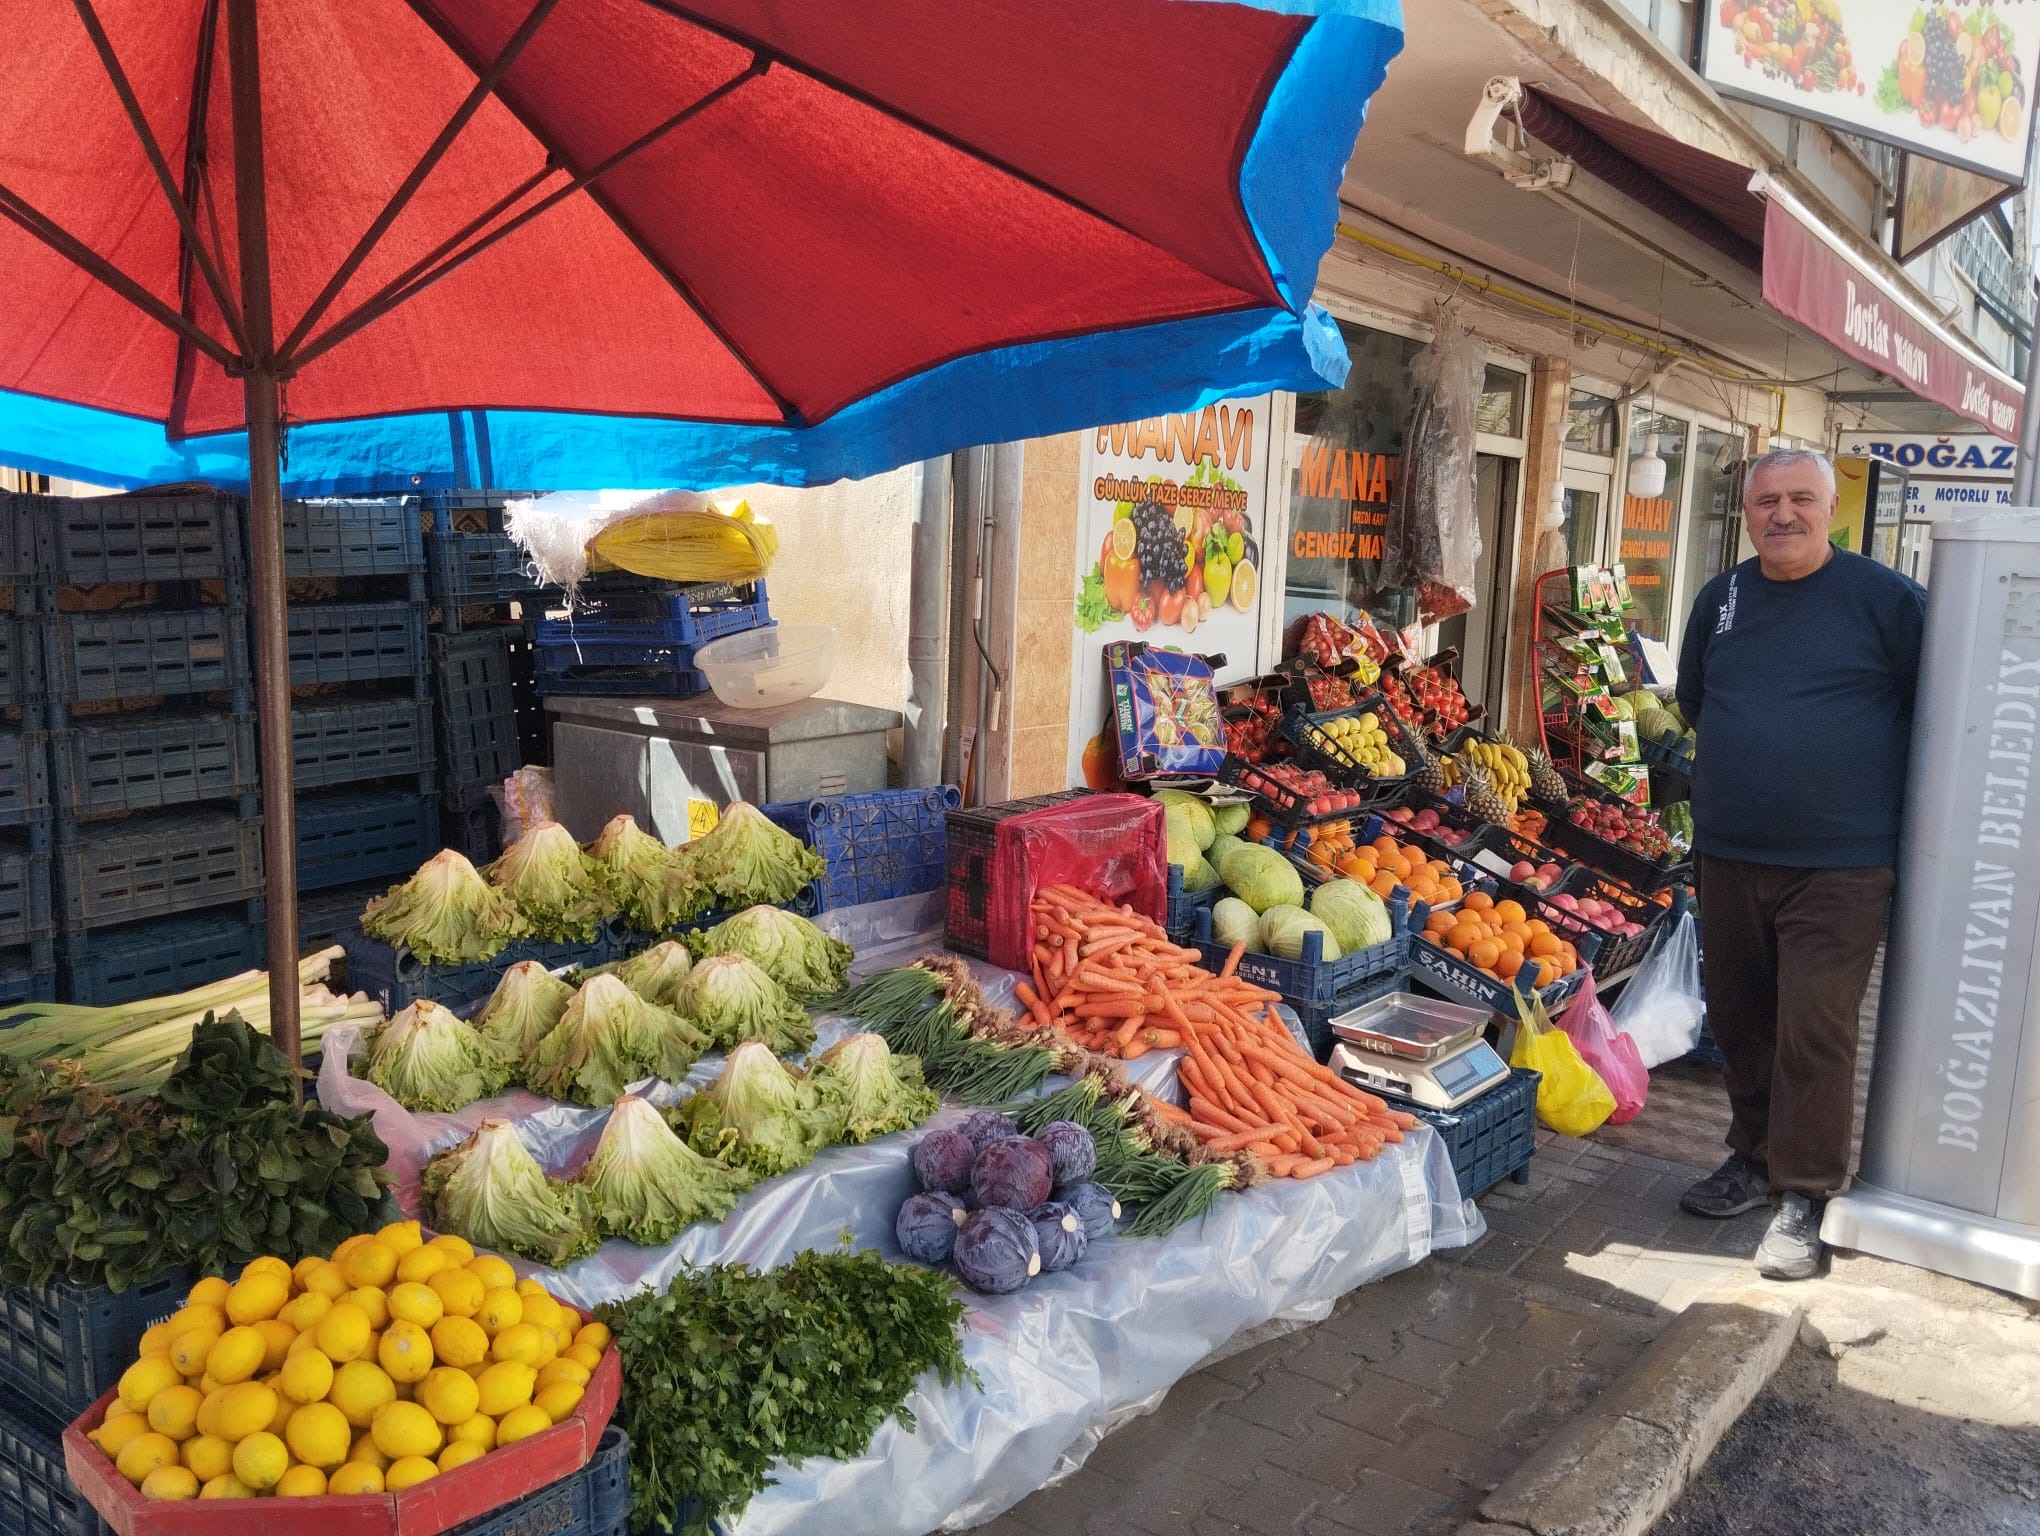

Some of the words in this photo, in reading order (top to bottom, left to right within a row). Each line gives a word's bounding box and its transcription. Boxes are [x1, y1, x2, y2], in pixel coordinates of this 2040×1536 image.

[1844, 279, 1889, 359] Dostlar
[1869, 437, 2016, 470] BOĞAZ
[1094, 472, 1148, 501] GÜNLÜK
[1150, 483, 1178, 505] TAZE
[1179, 485, 1213, 508] SEBZE
[1213, 489, 1248, 511] MEYVE
[1906, 486, 1919, 500] ER
[1935, 488, 1989, 503] MOTORLU
[1623, 494, 1673, 532] MANAV
[1294, 527, 1355, 560] CENGİZ
[1225, 958, 1276, 979] ENT
[1937, 859, 2016, 1153] BOĞAZLIYAN
